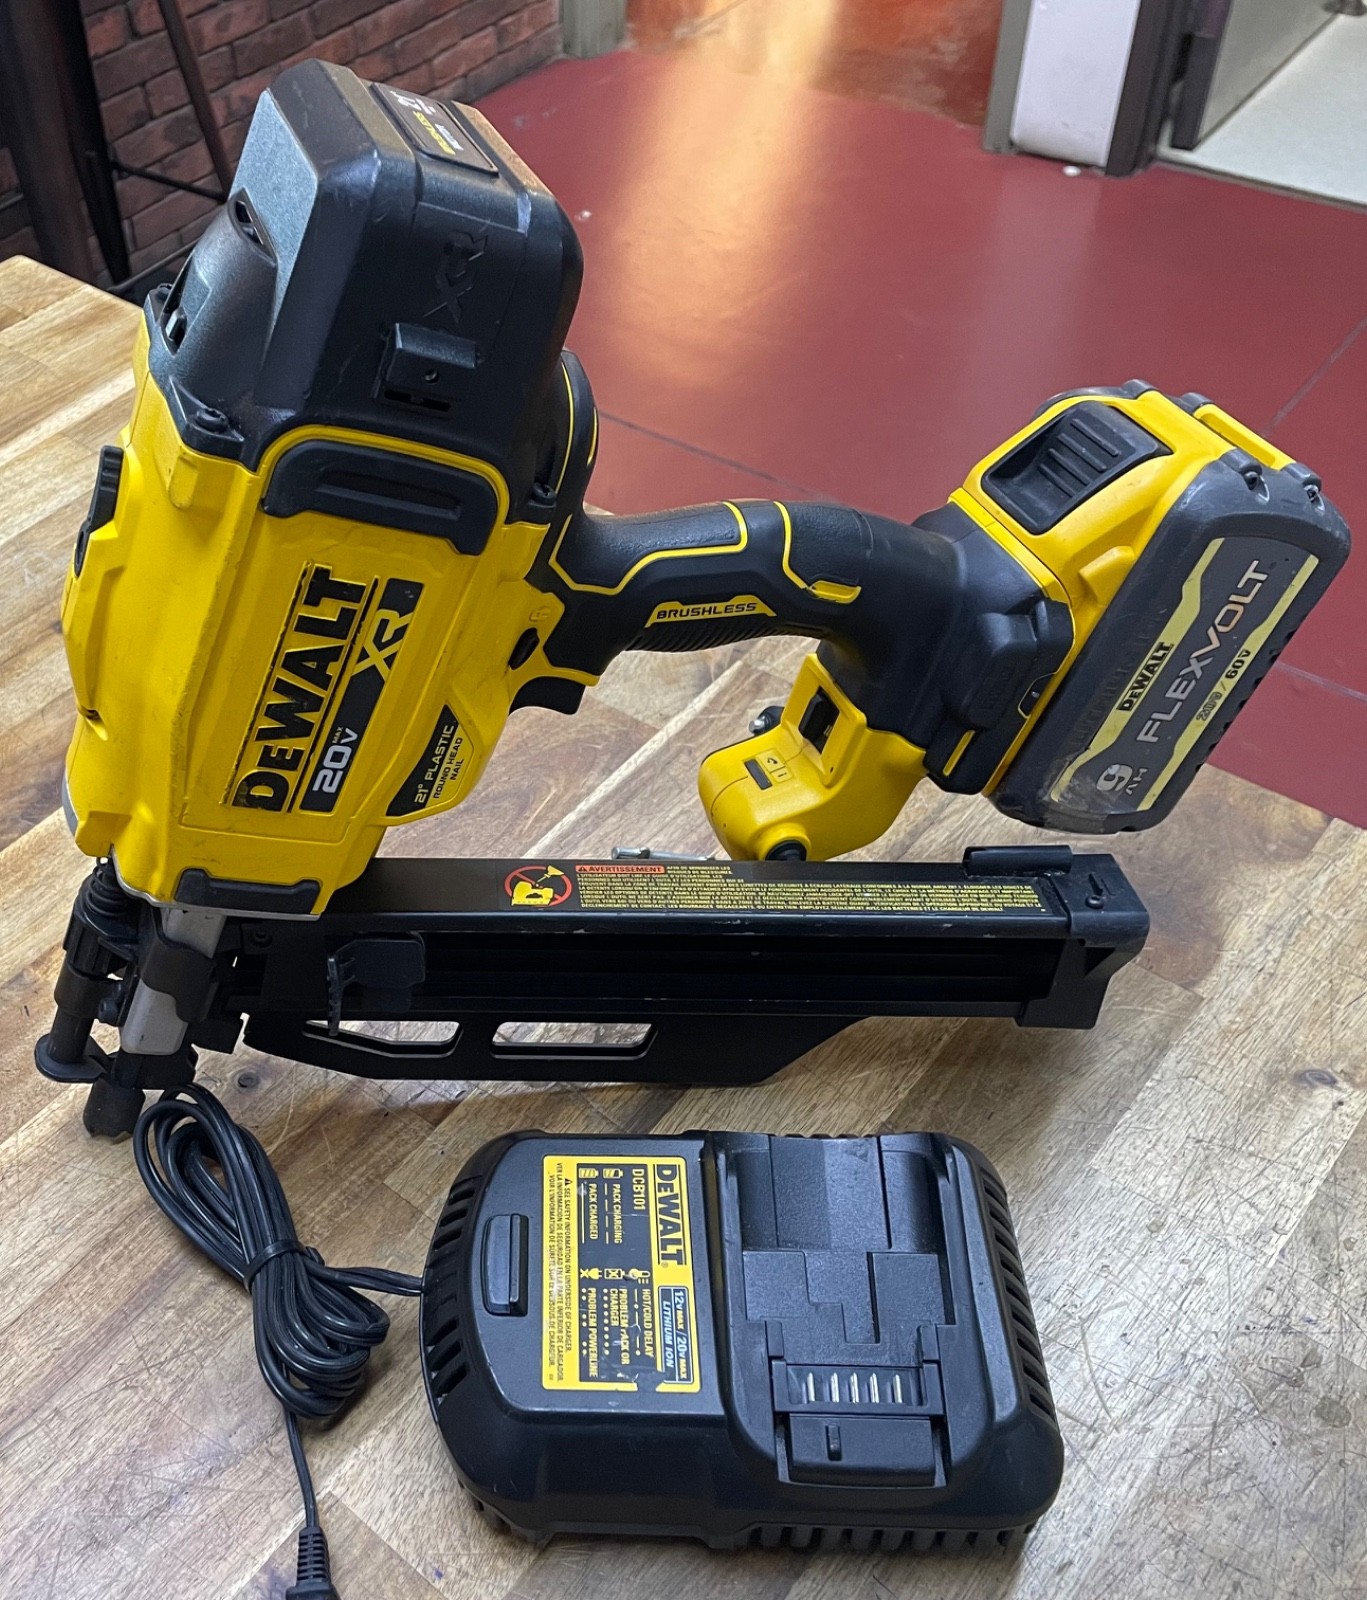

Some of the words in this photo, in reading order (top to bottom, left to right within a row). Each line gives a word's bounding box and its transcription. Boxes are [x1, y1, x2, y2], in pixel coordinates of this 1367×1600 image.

[656, 602, 758, 620] BRUSHLESS
[352, 609, 415, 682] XR
[1137, 560, 1268, 742] FLEXVOLT
[231, 564, 366, 812] DEWALT
[1116, 642, 1174, 712] DEWALT
[425, 725, 454, 782] PLASTIC
[433, 764, 451, 798] ROUND
[447, 737, 463, 764] HEAD
[450, 758, 464, 780] NAIL
[1096, 764, 1132, 792] 9
[632, 1168, 645, 1210] DCB101
[590, 1204, 598, 1239] CHARGED
[614, 1204, 622, 1244] CHARGING
[656, 1164, 683, 1265] DEWALT
[549, 1235, 555, 1243] DE
[565, 1265, 572, 1274] ON
[565, 1311, 572, 1320] OF
[588, 1288, 597, 1326] PROBLEM
[610, 1288, 619, 1326] CHARGER
[619, 1288, 628, 1327] PROBLEM
[642, 1289, 652, 1329] HOT/COLD
[663, 1301, 672, 1345] LITHIUM
[557, 1334, 564, 1343] DE
[589, 1328, 598, 1378] POWERLINE
[643, 1330, 654, 1358] DELAY
[665, 1346, 674, 1368] ION
[621, 1353, 630, 1364] OR
[679, 1358, 687, 1379] MAX
